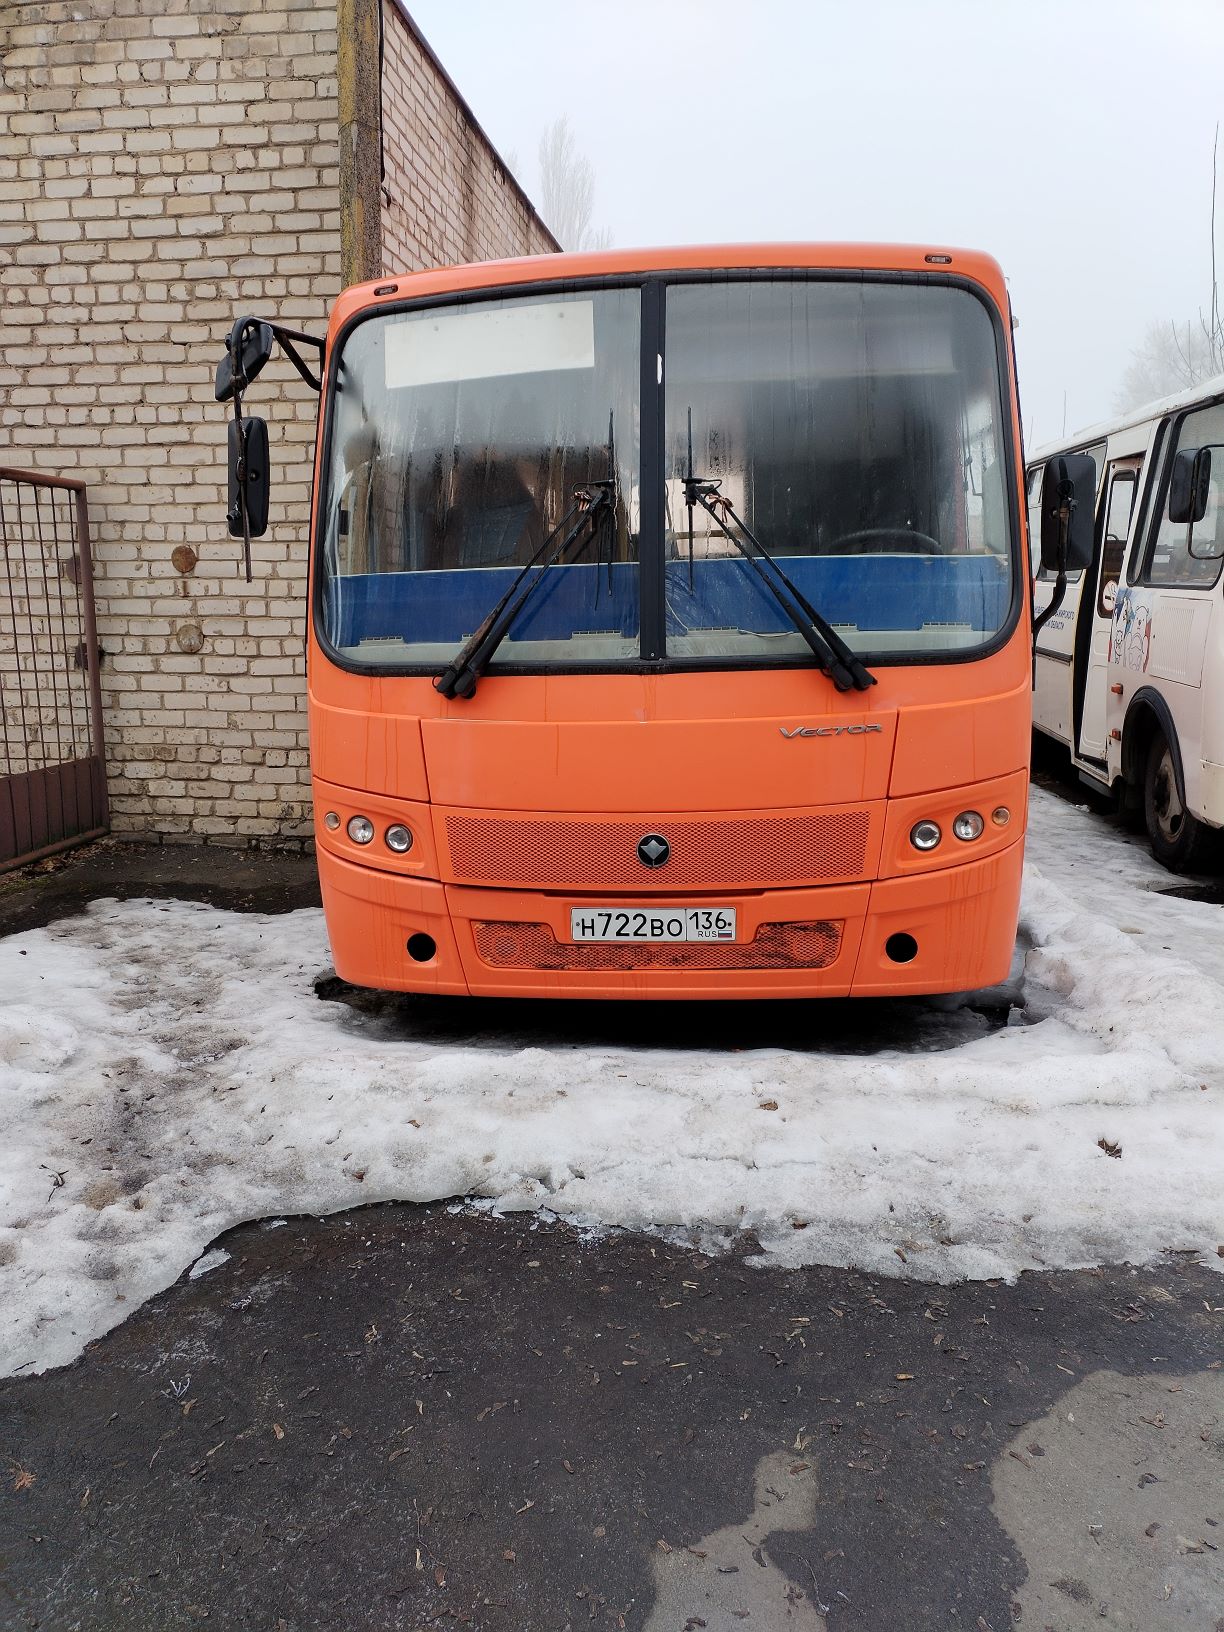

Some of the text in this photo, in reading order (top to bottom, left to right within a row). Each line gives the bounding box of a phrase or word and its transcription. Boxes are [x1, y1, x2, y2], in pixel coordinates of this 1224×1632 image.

[779, 723, 882, 738] VECTOR
[688, 911, 727, 930] 136
[697, 930, 718, 938] RUS
